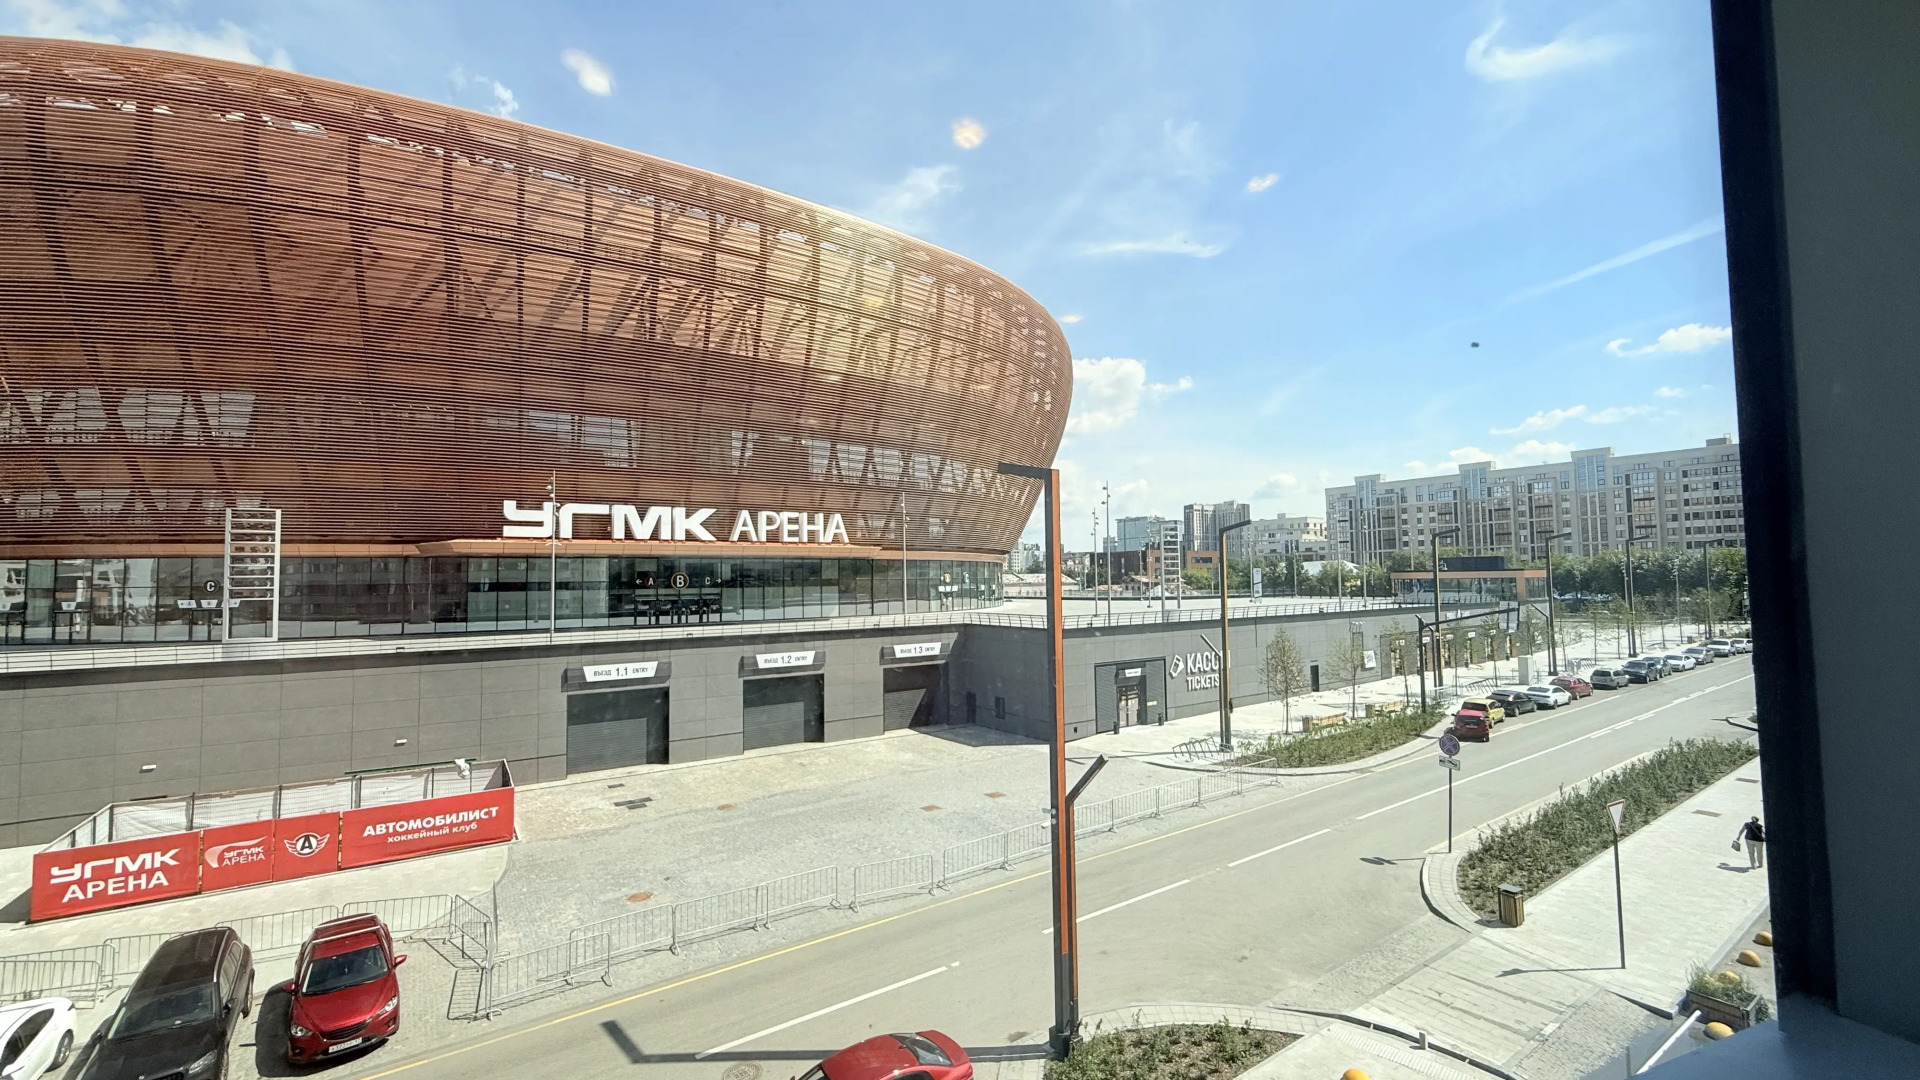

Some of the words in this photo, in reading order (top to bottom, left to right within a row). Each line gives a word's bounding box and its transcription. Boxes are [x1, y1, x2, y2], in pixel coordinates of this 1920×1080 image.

[503, 500, 717, 541] УГМК
[729, 509, 850, 543] АРЕНА
[206, 582, 215, 592] C
[676, 575, 685, 587] B
[704, 577, 711, 585] C
[781, 655, 792, 664] 1.2
[615, 667, 628, 677] 1.1
[1186, 673, 1220, 690] TICKETS
[363, 806, 499, 837] АВТОМОБИЛИСТ
[387, 826, 450, 843] хоккейный
[452, 822, 478, 834] клуб
[224, 845, 264, 858] УГМК
[50, 848, 181, 884] УГМК
[222, 853, 266, 867] АРЕНА
[62, 871, 169, 903] АРЕНА
